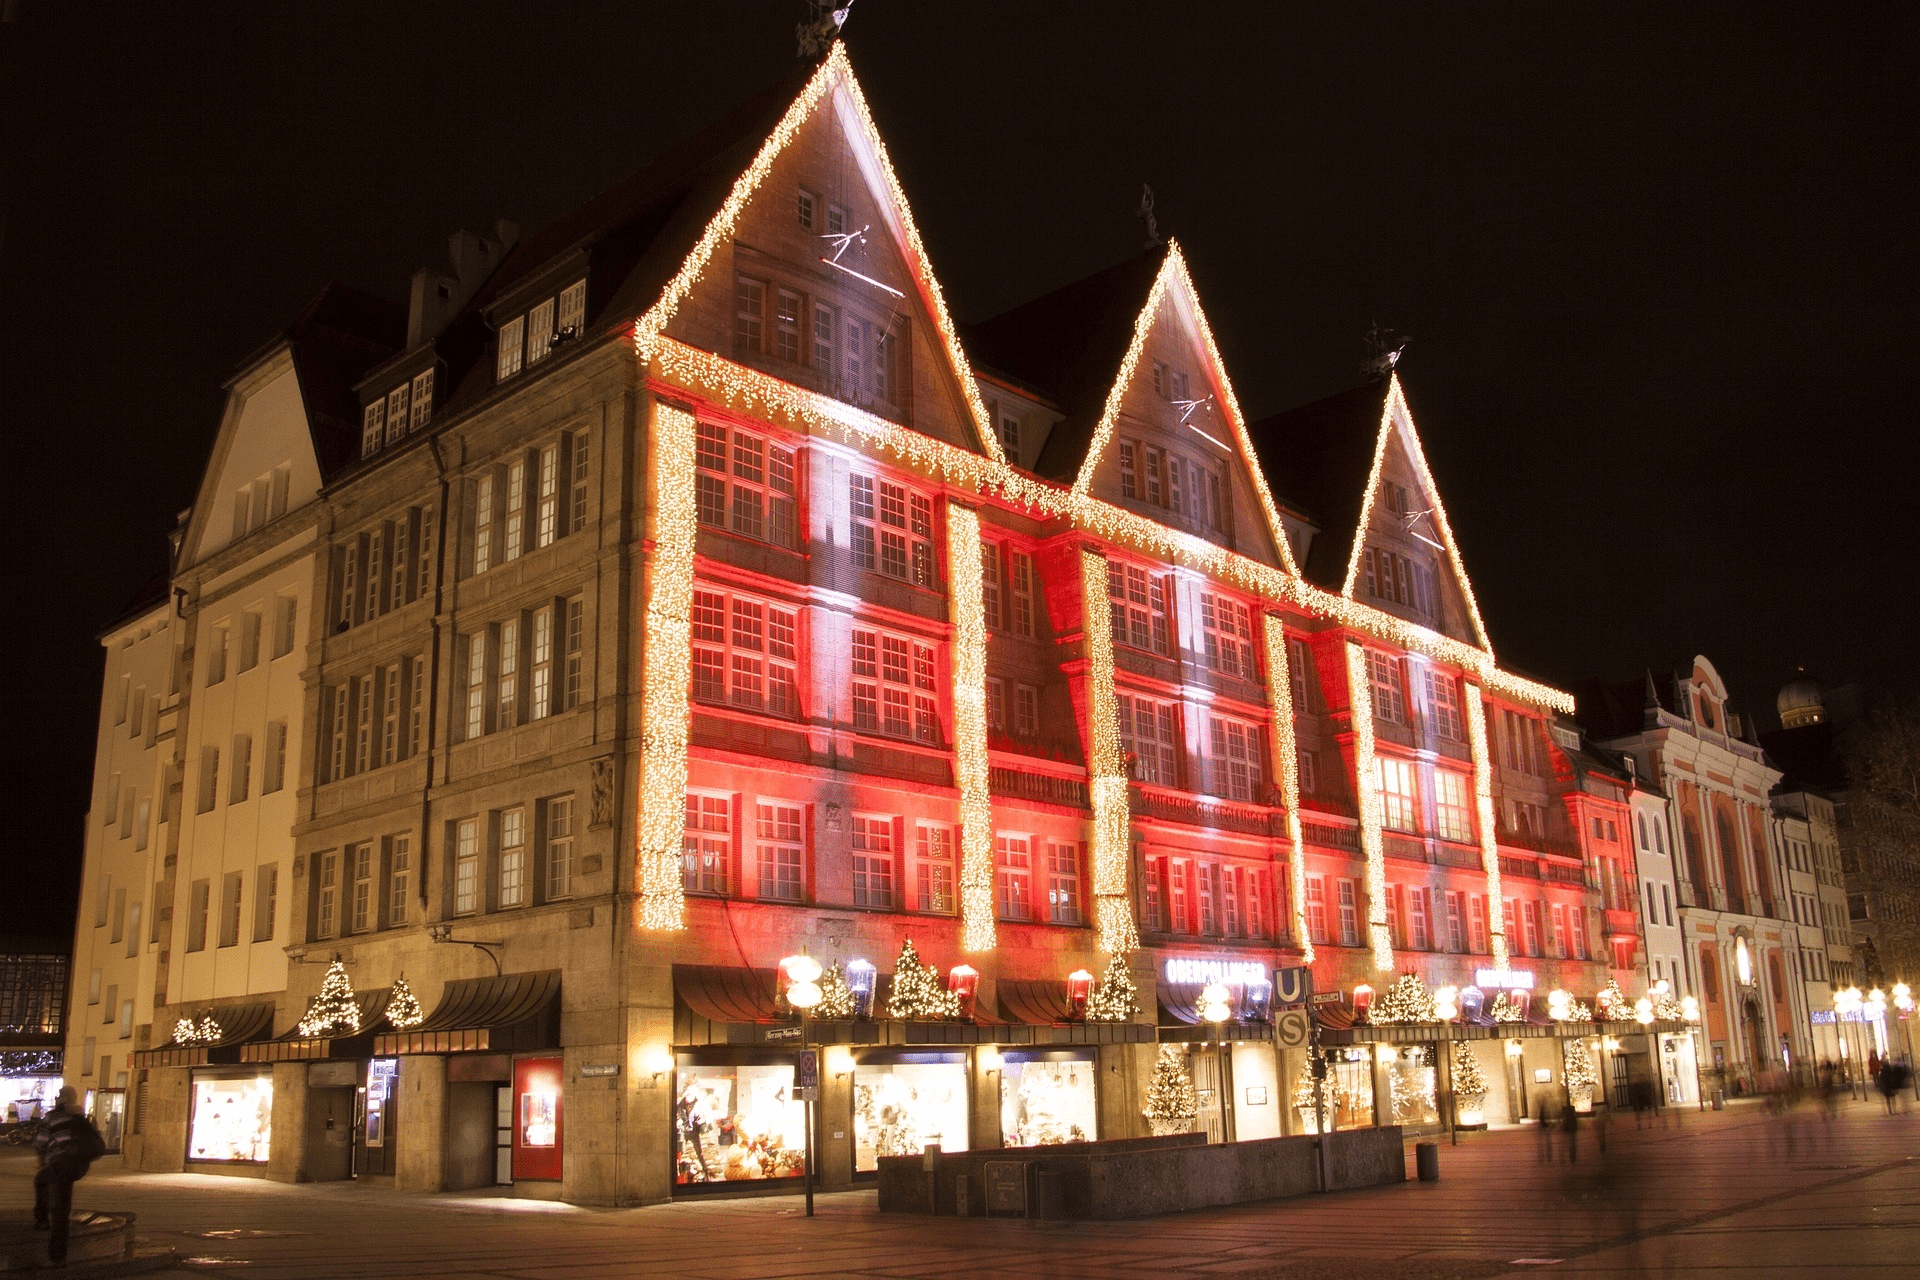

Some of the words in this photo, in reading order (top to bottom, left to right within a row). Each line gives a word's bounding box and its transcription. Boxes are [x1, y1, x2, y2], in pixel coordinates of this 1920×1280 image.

[1276, 969, 1300, 1002] U
[1282, 1015, 1302, 1043] S
[803, 1075, 817, 1086] TAXI
